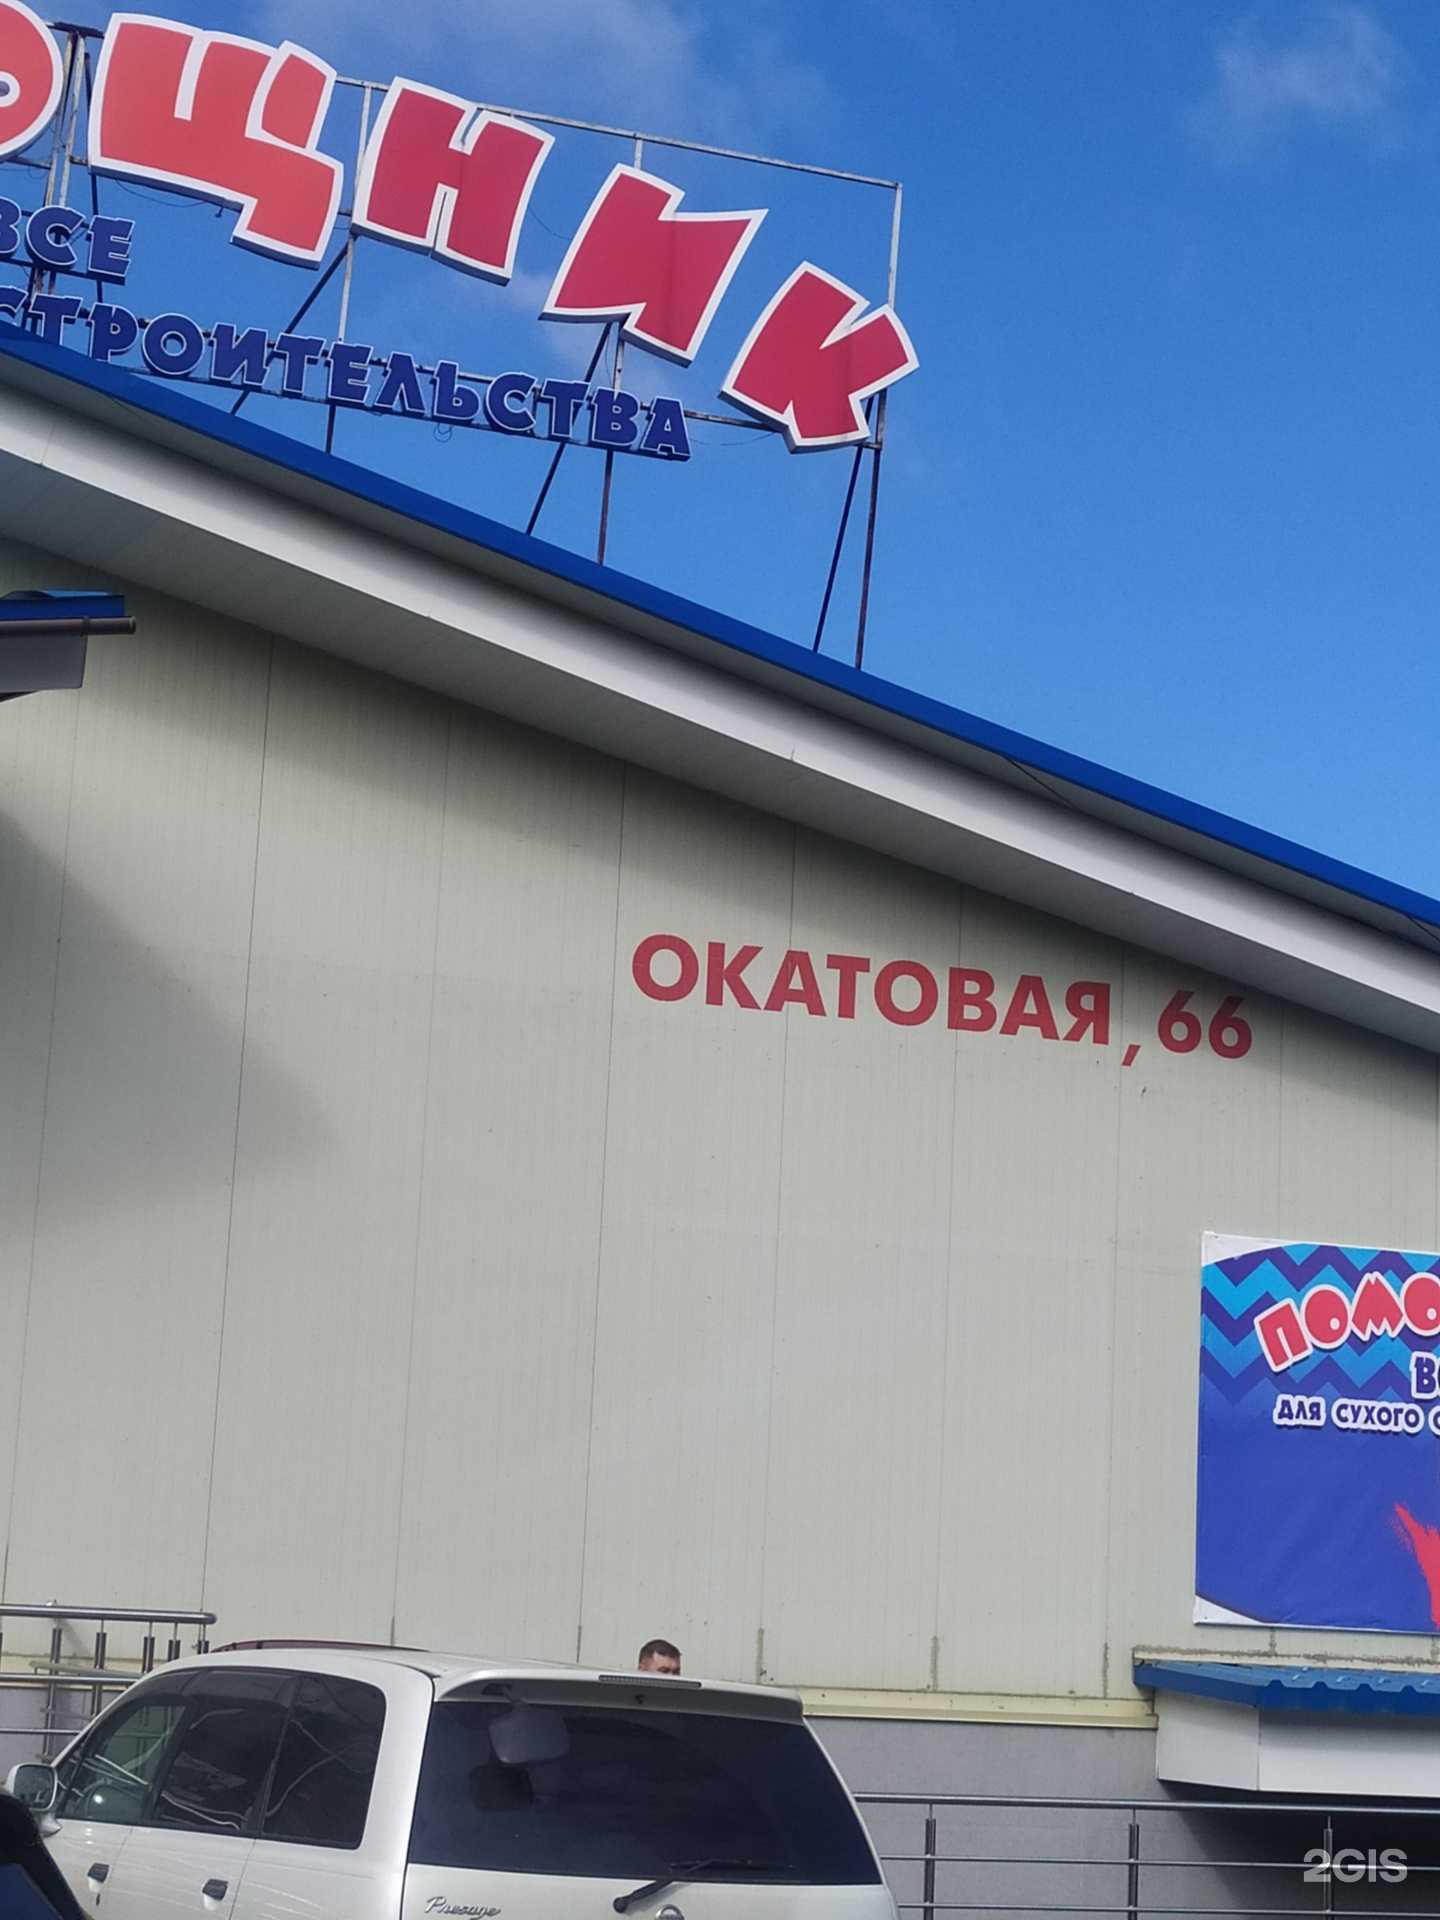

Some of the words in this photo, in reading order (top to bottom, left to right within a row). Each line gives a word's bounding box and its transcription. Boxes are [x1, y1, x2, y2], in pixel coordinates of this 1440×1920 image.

[632, 934, 1140, 1066] ОКАТОВАЯ,
[1157, 990, 1252, 1059] 66
[1275, 1397, 1323, 1423] ДЛЯ
[1334, 1401, 1421, 1430] СУХОГО
[424, 1896, 501, 1920] Presage
